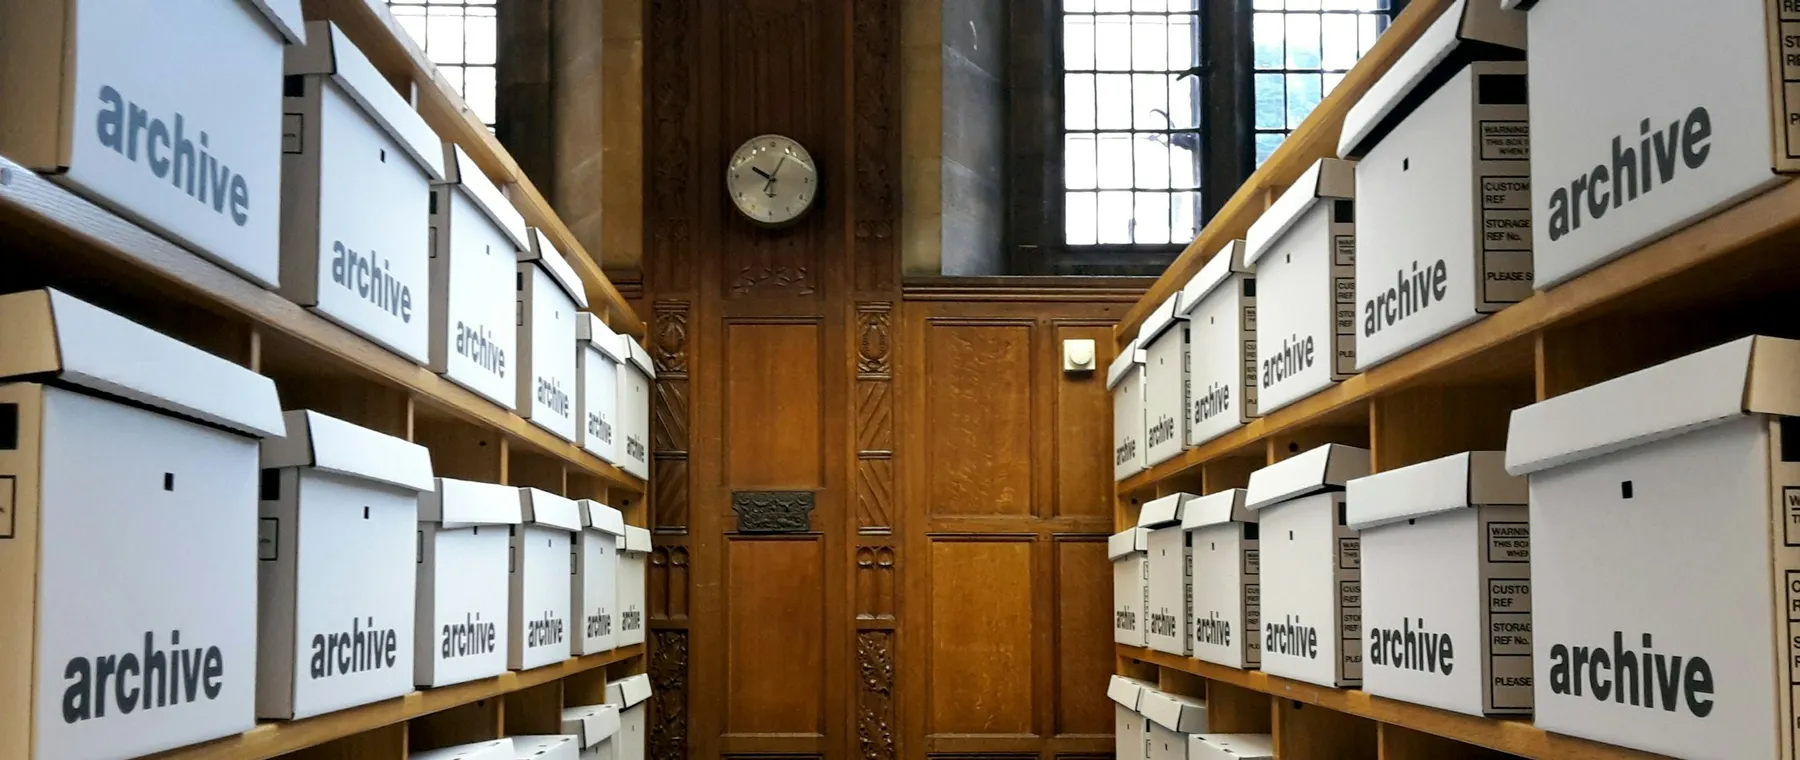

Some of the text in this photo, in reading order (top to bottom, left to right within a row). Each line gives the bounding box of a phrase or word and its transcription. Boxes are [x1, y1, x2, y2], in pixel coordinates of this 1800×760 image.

[97, 85, 249, 227] archive
[1549, 106, 1712, 242] archive
[1485, 195, 1506, 204] REF
[1486, 219, 1531, 228] STORAGE
[1486, 231, 1505, 241] REF
[332, 240, 412, 325] archive
[1487, 271, 1524, 281] PLEASE
[1365, 259, 1447, 338] archive
[456, 321, 505, 378] archive
[1263, 334, 1314, 389] archive
[538, 376, 569, 418] archive
[1195, 382, 1229, 424] archive
[589, 412, 611, 445] archive
[1149, 414, 1174, 448] archive
[627, 434, 644, 463] archive
[1116, 436, 1135, 466] archive
[1493, 540, 1512, 548] THIS
[622, 605, 640, 631] archive
[1117, 606, 1135, 630] archive
[1493, 598, 1514, 607] REF
[442, 613, 495, 659] archive
[528, 611, 563, 648] archive
[587, 608, 610, 638] archive
[1151, 608, 1175, 637] archive
[1197, 611, 1230, 647] archive
[1266, 615, 1317, 659] archive
[311, 617, 396, 679] archive
[1371, 617, 1453, 676] archive
[1494, 636, 1512, 645] REF
[62, 630, 223, 724] archive
[1494, 677, 1532, 687] PLEASE
[1550, 631, 1714, 717] archive
